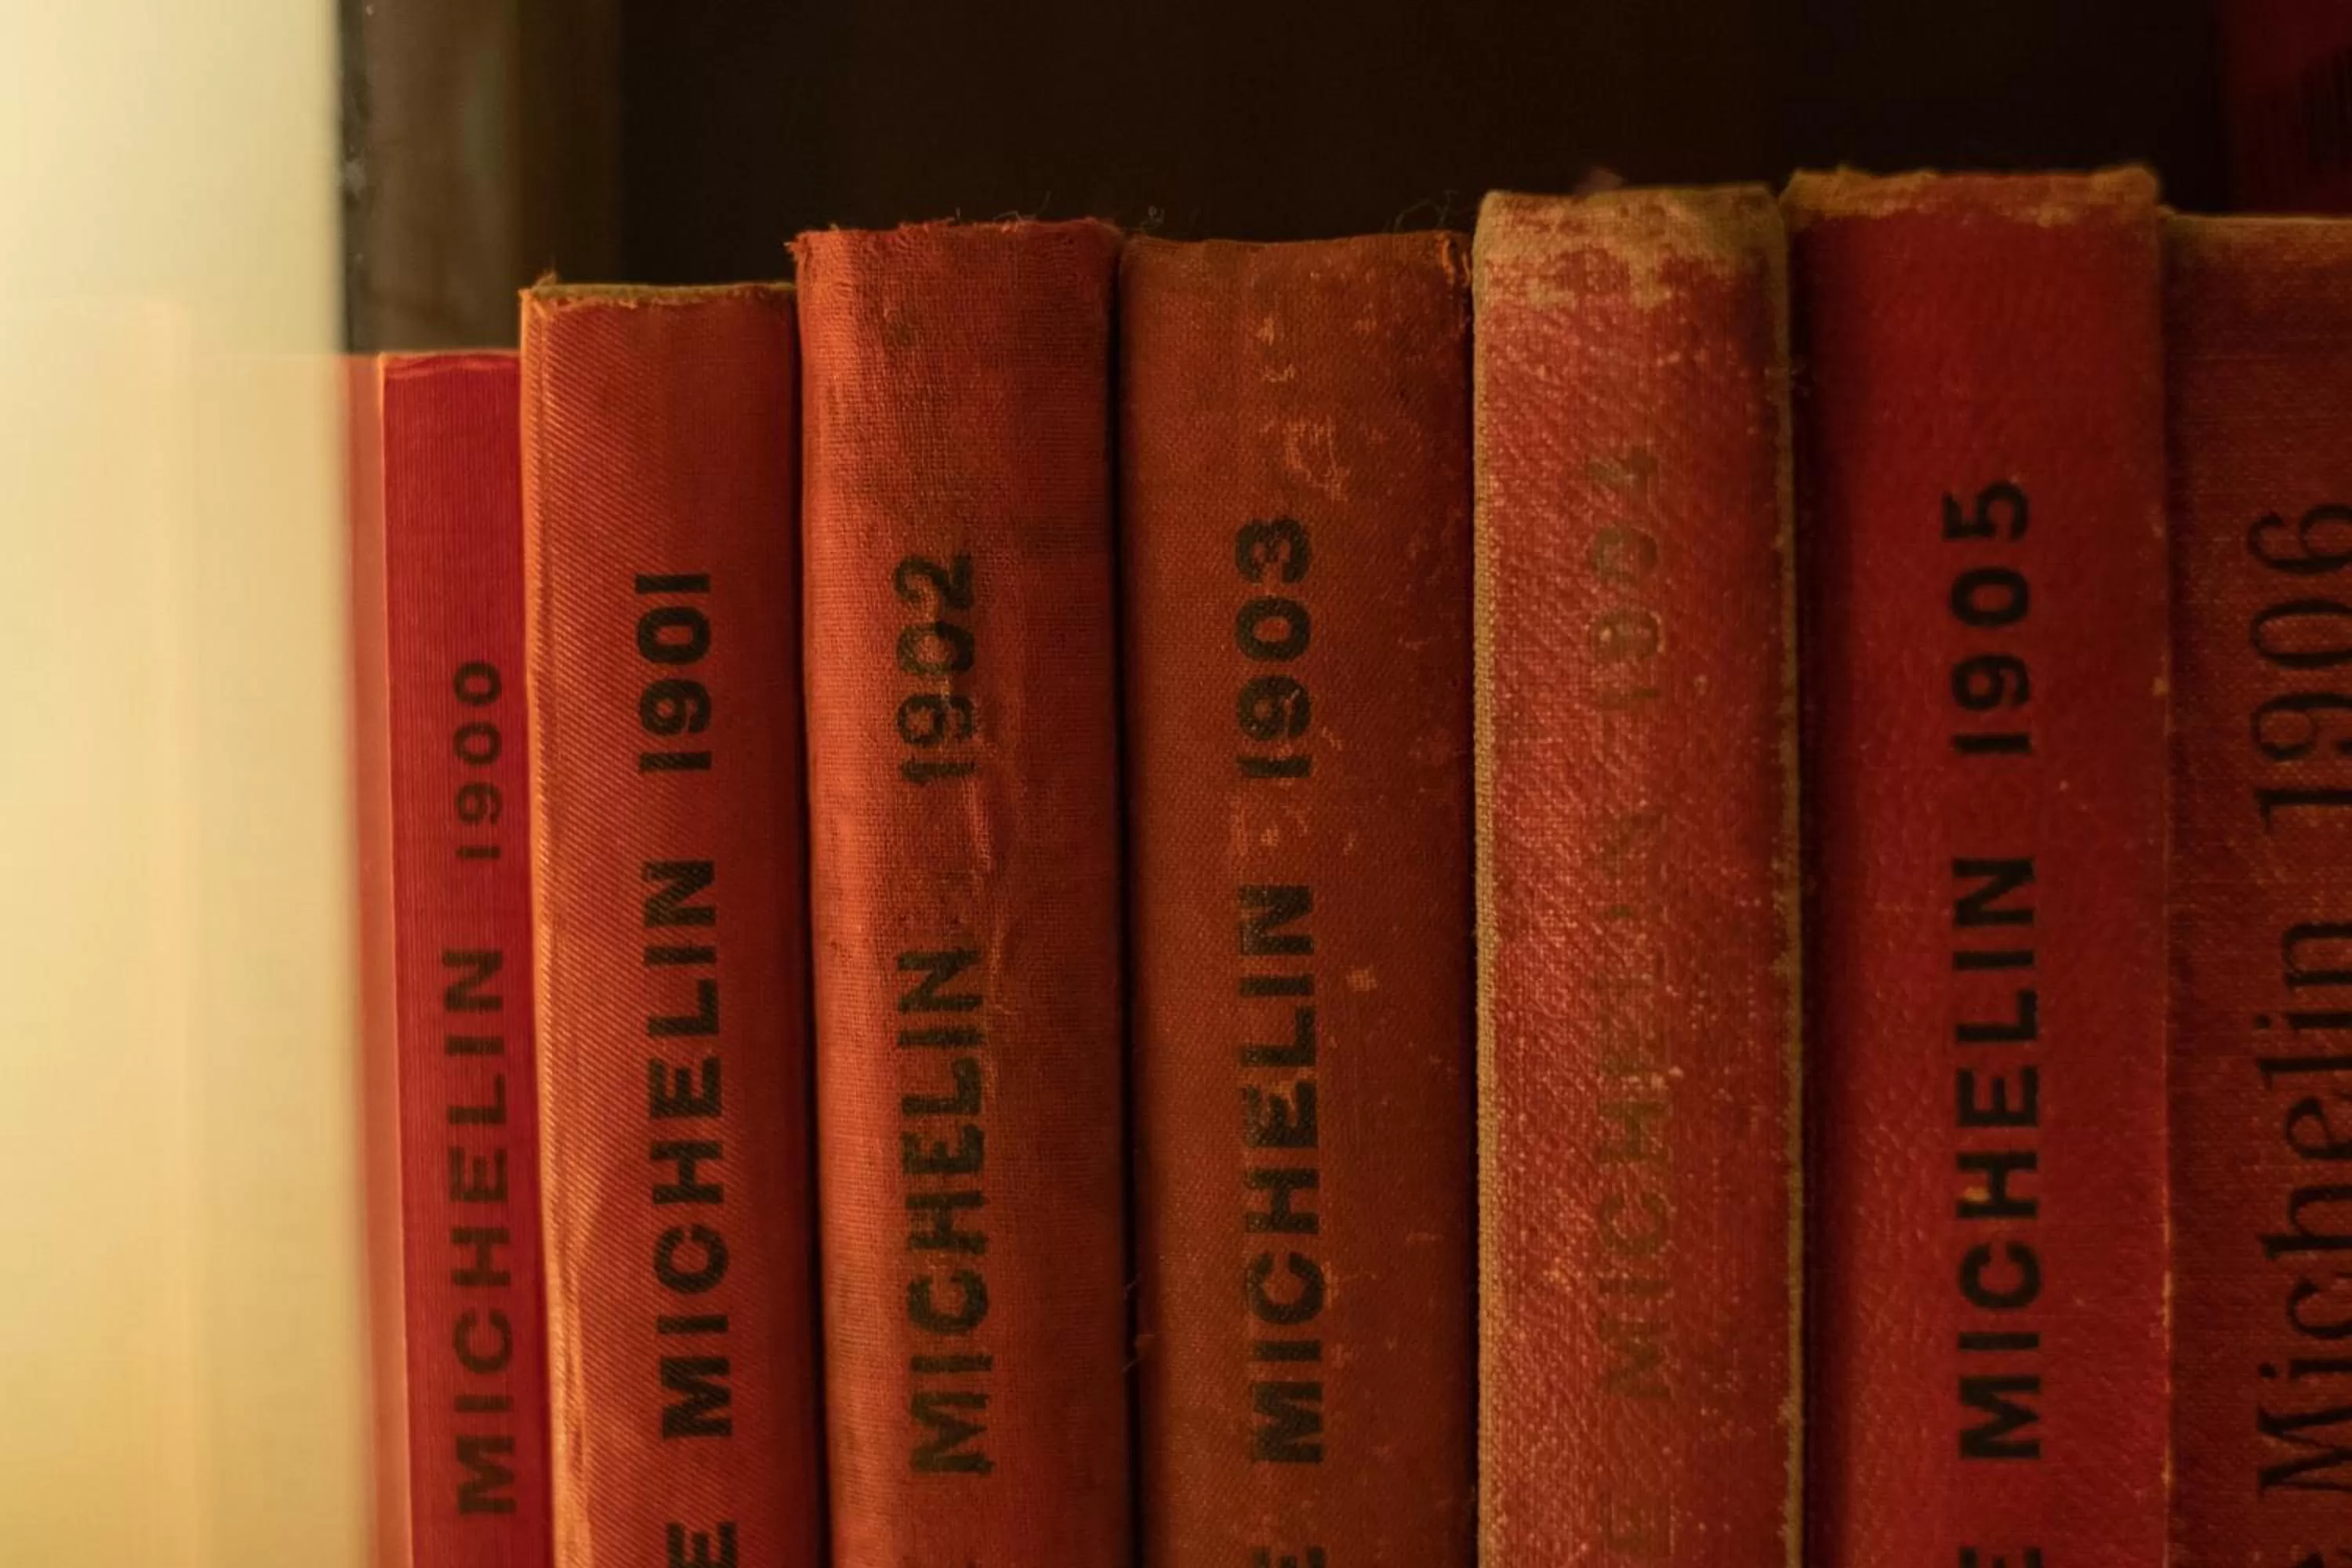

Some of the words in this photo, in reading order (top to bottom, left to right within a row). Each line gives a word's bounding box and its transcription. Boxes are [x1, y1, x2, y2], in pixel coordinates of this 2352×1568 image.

[454, 661, 501, 859] 1900
[633, 574, 711, 773] 1901
[893, 553, 977, 787] 1902
[1236, 516, 1312, 779] 1903
[1940, 480, 2032, 756] 1905
[2248, 503, 2352, 835] 1906
[444, 950, 515, 1515] MICHELIN
[643, 860, 732, 1439] MICHELIN
[896, 947, 994, 1477] MICHELIN
[1239, 885, 1325, 1464] MICHELIN
[1951, 856, 2042, 1461] MICHELIN
[2253, 920, 2352, 1499] Michelin
